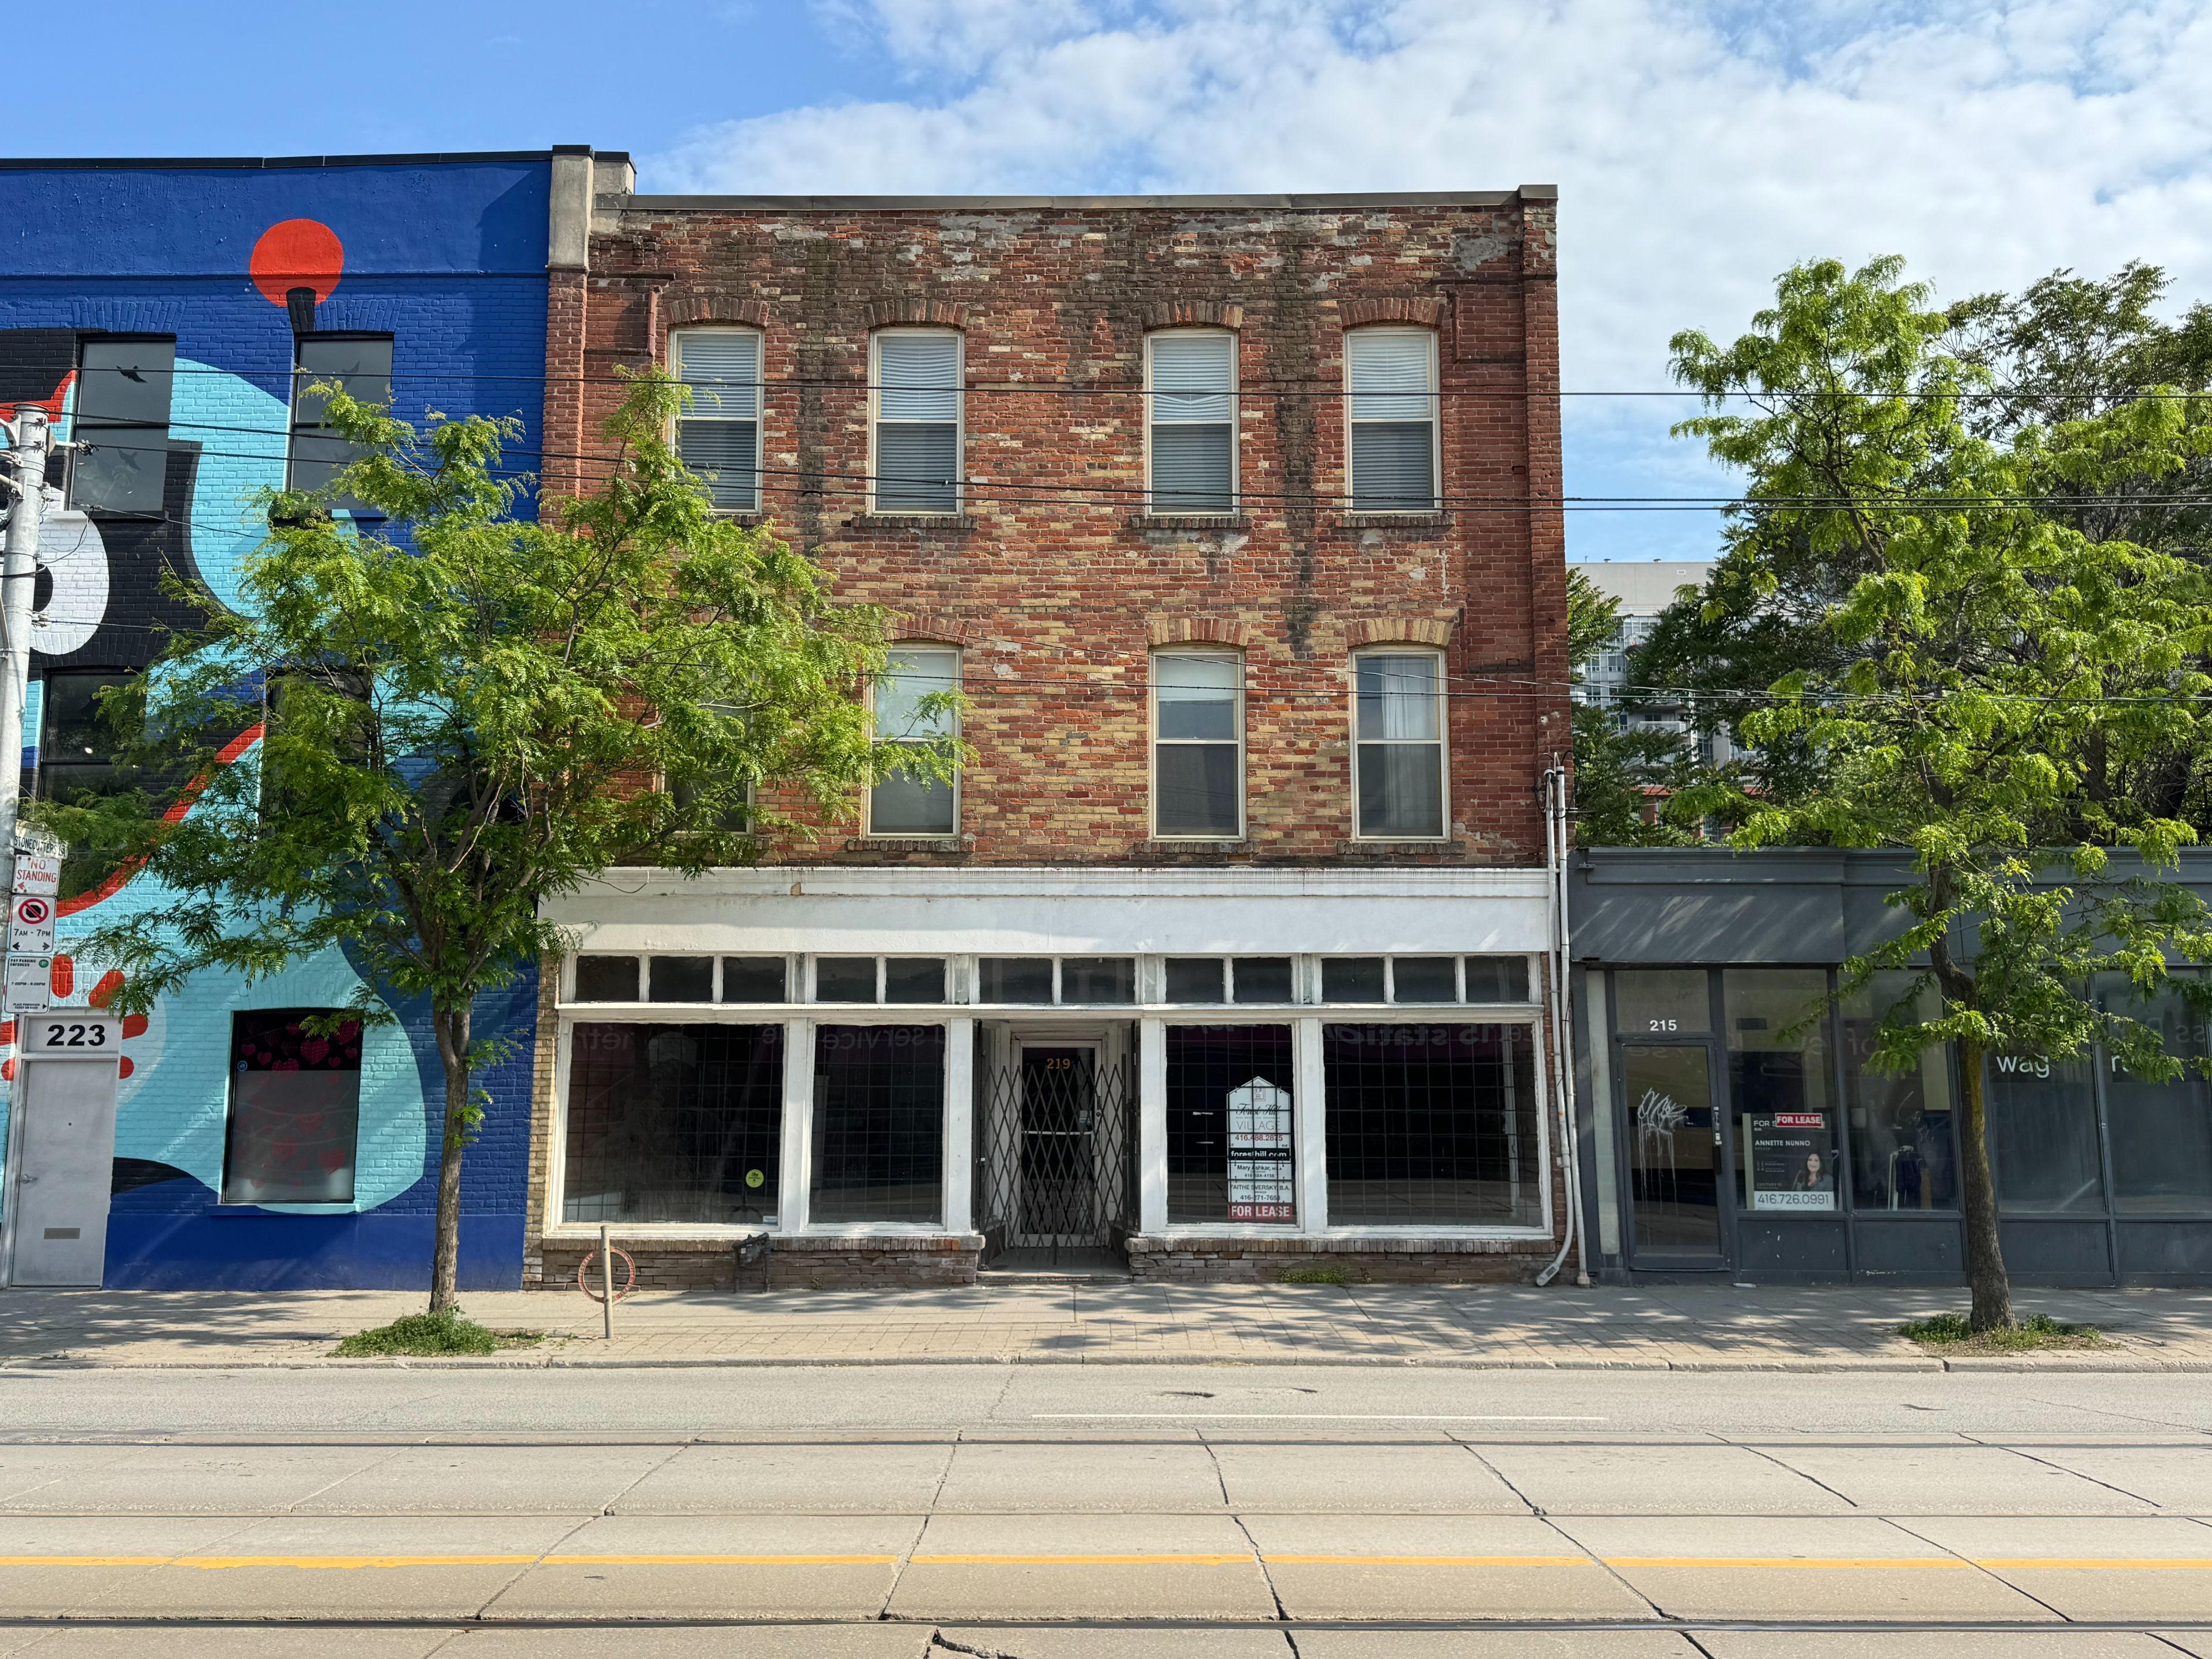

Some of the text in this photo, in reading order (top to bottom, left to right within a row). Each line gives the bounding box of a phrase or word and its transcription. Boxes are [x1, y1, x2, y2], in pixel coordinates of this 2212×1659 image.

[14, 835, 58, 854] STONECUTTERS
[31, 858, 46, 870] NO
[16, 869, 57, 882] STANDING
[14, 928, 28, 936] 7AM
[36, 929, 51, 937] 7PM
[1649, 1019, 1677, 1031] 215
[46, 1024, 105, 1046] 223
[1047, 1058, 1070, 1069] 219
[1996, 1055, 2050, 1078] wag
[1236, 1103, 1282, 1116] Forest Hill
[1236, 1120, 1281, 1130] VILLAGE
[1230, 1150, 1287, 1158] foresthillcom
[1758, 1194, 1830, 1205] 416.726.0991
[1231, 1205, 1291, 1218] FOR LEASE
